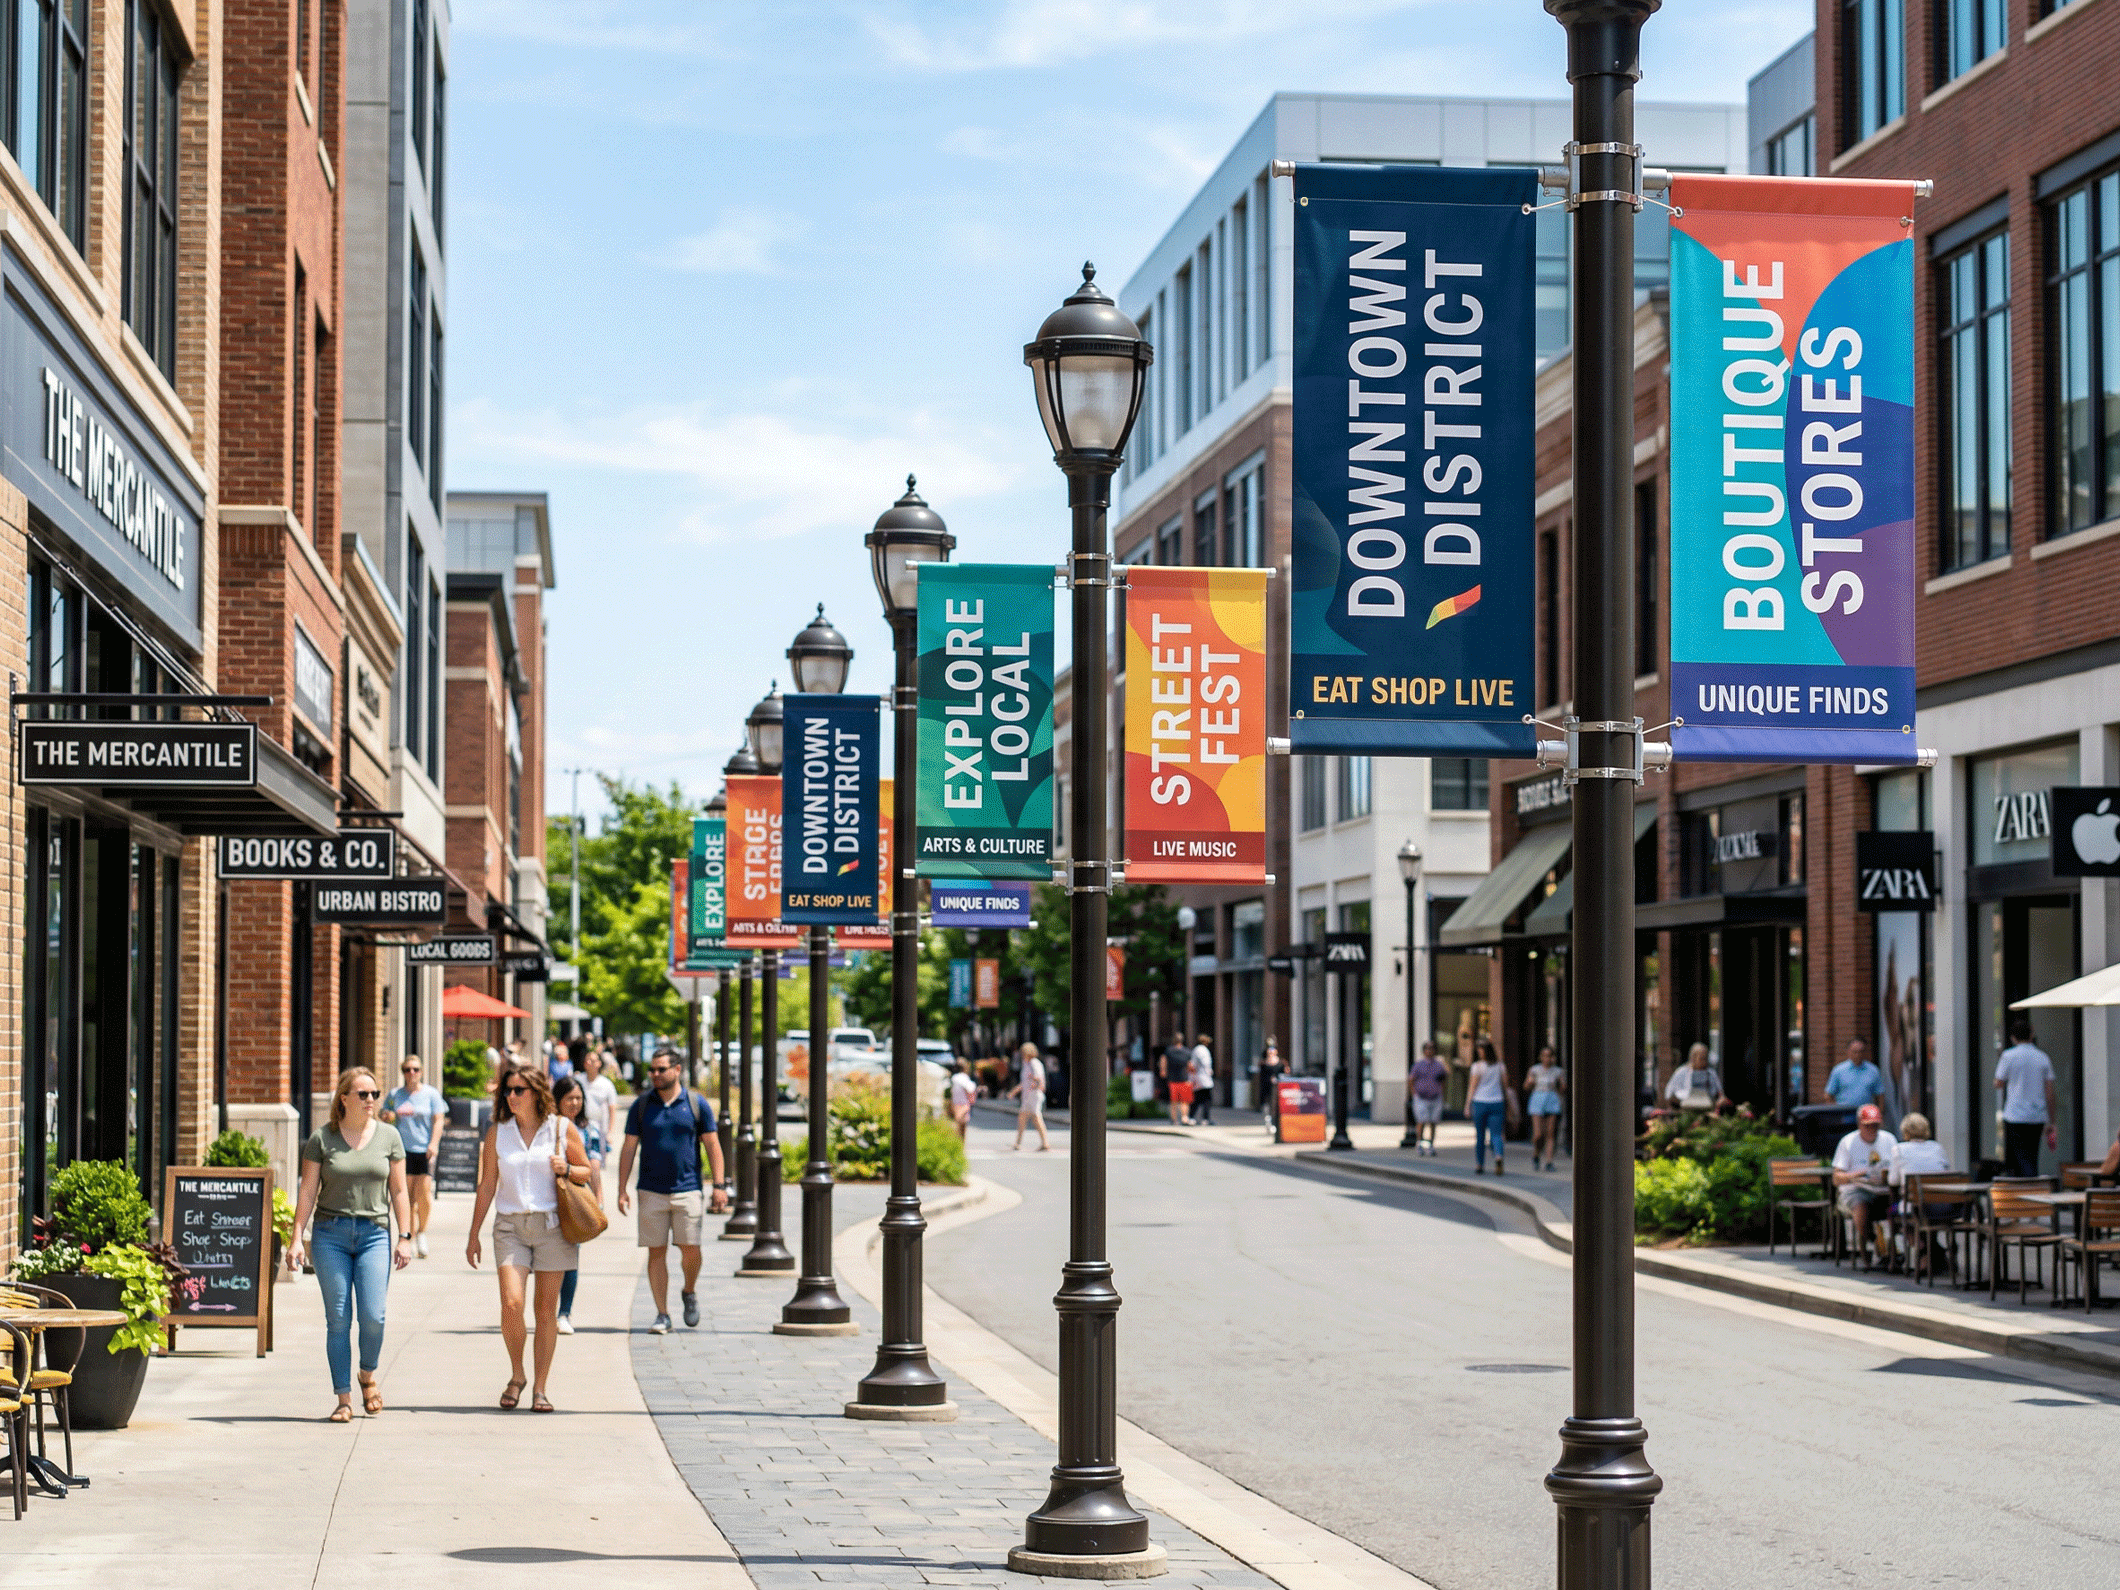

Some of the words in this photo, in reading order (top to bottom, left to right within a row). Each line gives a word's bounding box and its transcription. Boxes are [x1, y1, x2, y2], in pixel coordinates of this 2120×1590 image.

[1347, 229, 1408, 618] DOWNTOWN
[1423, 249, 1484, 566] DISTRICT
[1722, 260, 1790, 631] BOUTIQUE
[42, 366, 84, 488] THE
[86, 417, 185, 591] MERCANTILE
[1800, 325, 1864, 615] STORES
[944, 598, 984, 809] EXPLORE
[990, 632, 1030, 781] LOCAL
[1150, 613, 1192, 806] STREET
[1200, 644, 1241, 764] FEST
[1313, 676, 1363, 703] EAT
[1370, 677, 1446, 705] SHOP
[1454, 679, 1514, 706] LIVE
[1698, 684, 1800, 716] UNIQUE
[1808, 687, 1889, 715] FINDS
[34, 741, 79, 767] THE
[88, 742, 243, 768] MERCANTILE
[802, 717, 829, 874] DOWNTOWN
[834, 728, 860, 853] DISTRICT
[1994, 791, 2050, 843] ZARA
[228, 838, 312, 869] BOOKS
[319, 839, 338, 869] &
[345, 840, 386, 869] CO.
[923, 837, 962, 853] ARTS
[965, 838, 976, 853] &
[980, 838, 1045, 854] CULTURE
[1153, 841, 1186, 857] LIVE
[1189, 842, 1237, 857] MUSIC
[318, 890, 375, 911] URBAN
[380, 891, 442, 912] BISTRO
[705, 833, 724, 929] EXPLORE
[789, 894, 810, 907] EAT
[813, 895, 844, 908] SHOP
[847, 896, 872, 908] LIVE
[1862, 868, 1931, 900] ZARA
[940, 896, 983, 911] UNIQUE
[985, 897, 1020, 911] FINDS
[449, 942, 491, 958] GOODS
[200, 1182, 259, 1194] MERCANTILE
[184, 1210, 205, 1226] Eat
